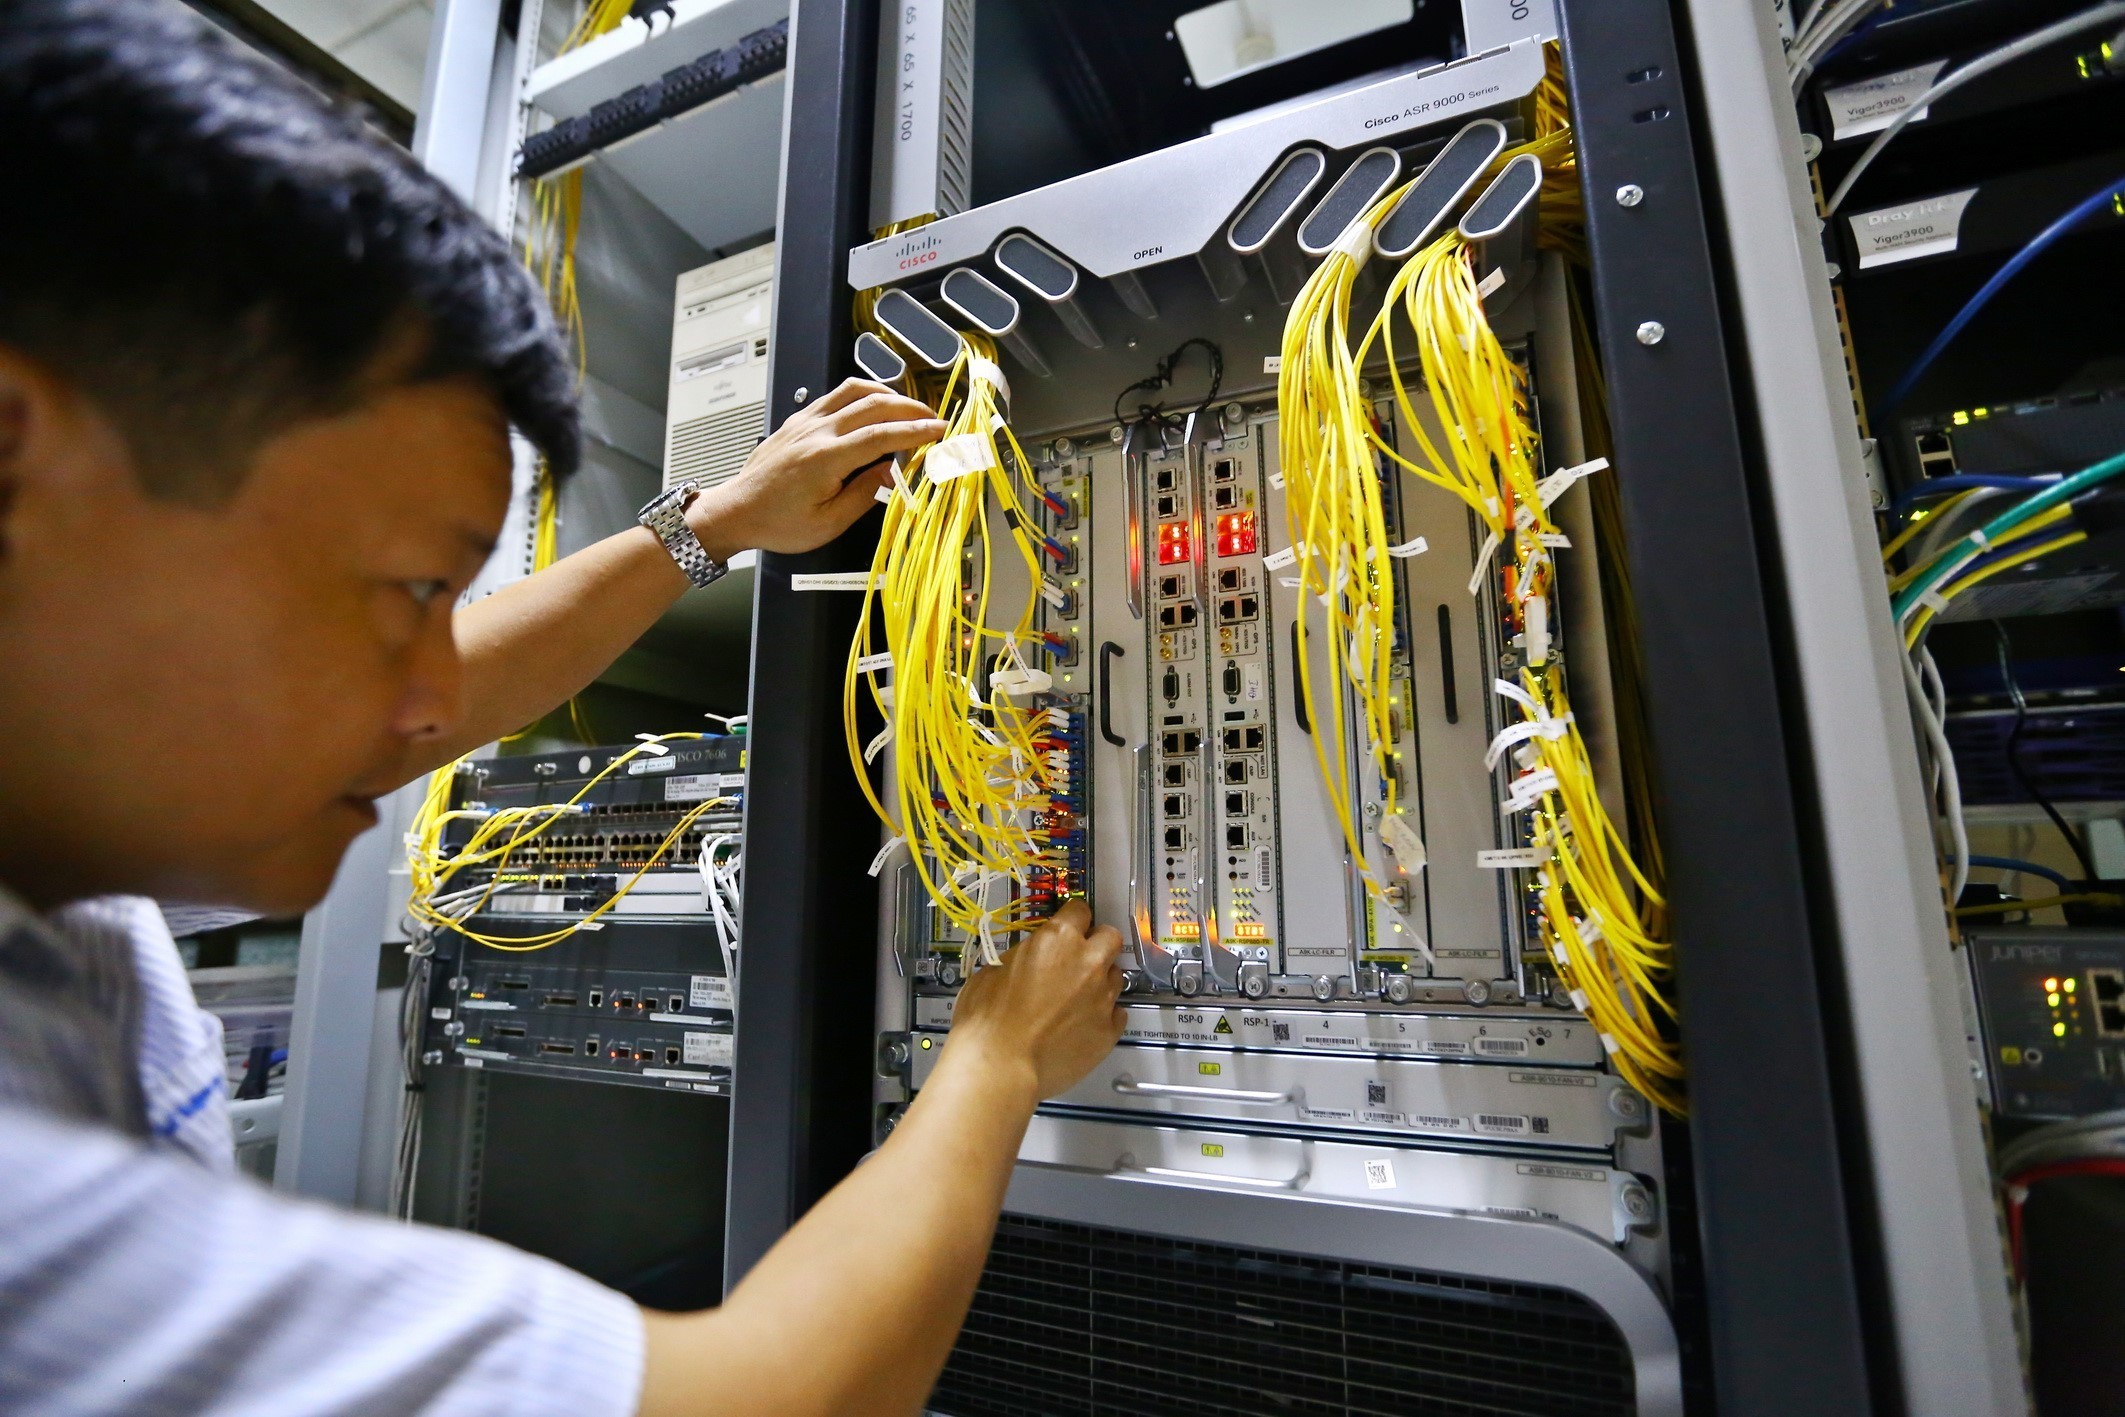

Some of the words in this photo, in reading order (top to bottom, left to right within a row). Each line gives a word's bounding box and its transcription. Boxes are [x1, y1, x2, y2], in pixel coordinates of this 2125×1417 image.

[905, 6, 917, 25] 65
[903, 53, 915, 72] 65
[1364, 114, 1399, 129] Cisco
[1403, 103, 1430, 118] ASR
[1433, 92, 1465, 109] 9000
[1468, 84, 1500, 99] Series
[1847, 96, 1906, 116] Vigor3900
[901, 102, 913, 141] 1700
[1873, 225, 1934, 244] Vigor3900
[1133, 245, 1163, 260] OPEN
[899, 251, 938, 270] CISCO
[1178, 1014, 1203, 1024] RSP-0
[1243, 1017, 1269, 1027] RSP-1
[1323, 1020, 1329, 1029] 4
[1130, 1030, 1142, 1038] ARE
[1144, 1031, 1179, 1039] TIGHTENED
[1399, 1023, 1405, 1033] 5
[1480, 1025, 1487, 1036] 6
[1563, 1029, 1571, 1039] 7
